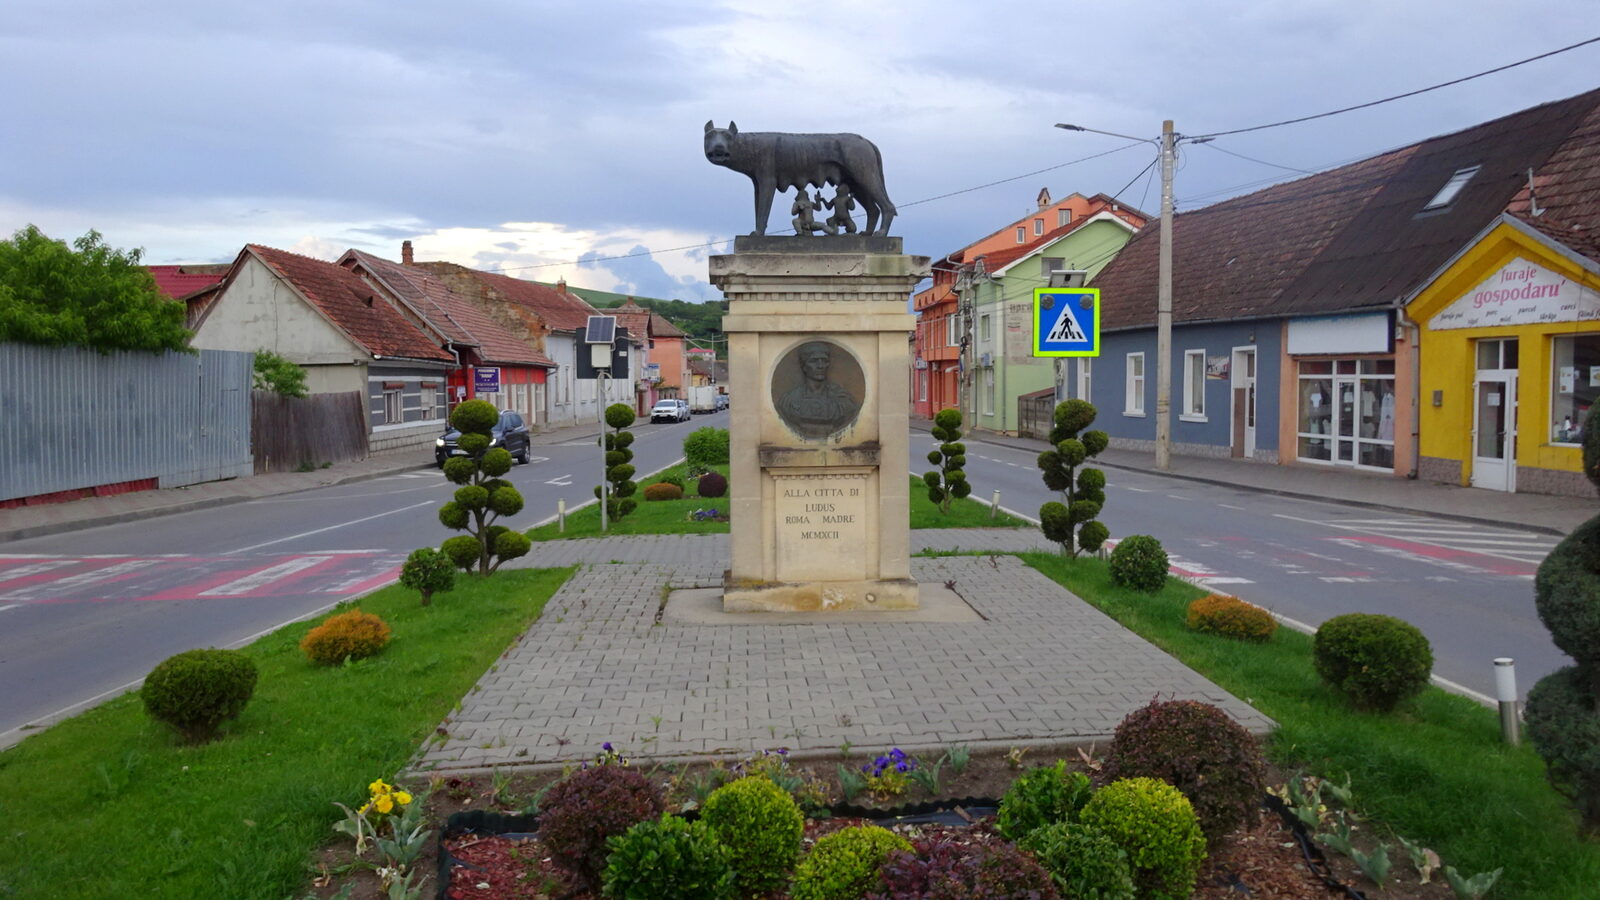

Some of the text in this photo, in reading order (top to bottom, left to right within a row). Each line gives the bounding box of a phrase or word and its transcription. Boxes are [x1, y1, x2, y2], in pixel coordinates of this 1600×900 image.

[1500, 265, 1537, 283] furaje
[784, 488, 859, 498] ALLA CITTA DI
[805, 503, 836, 513] LUDUS
[785, 515, 855, 525] ROMA MADRE
[801, 531, 839, 540] MCMXCII
